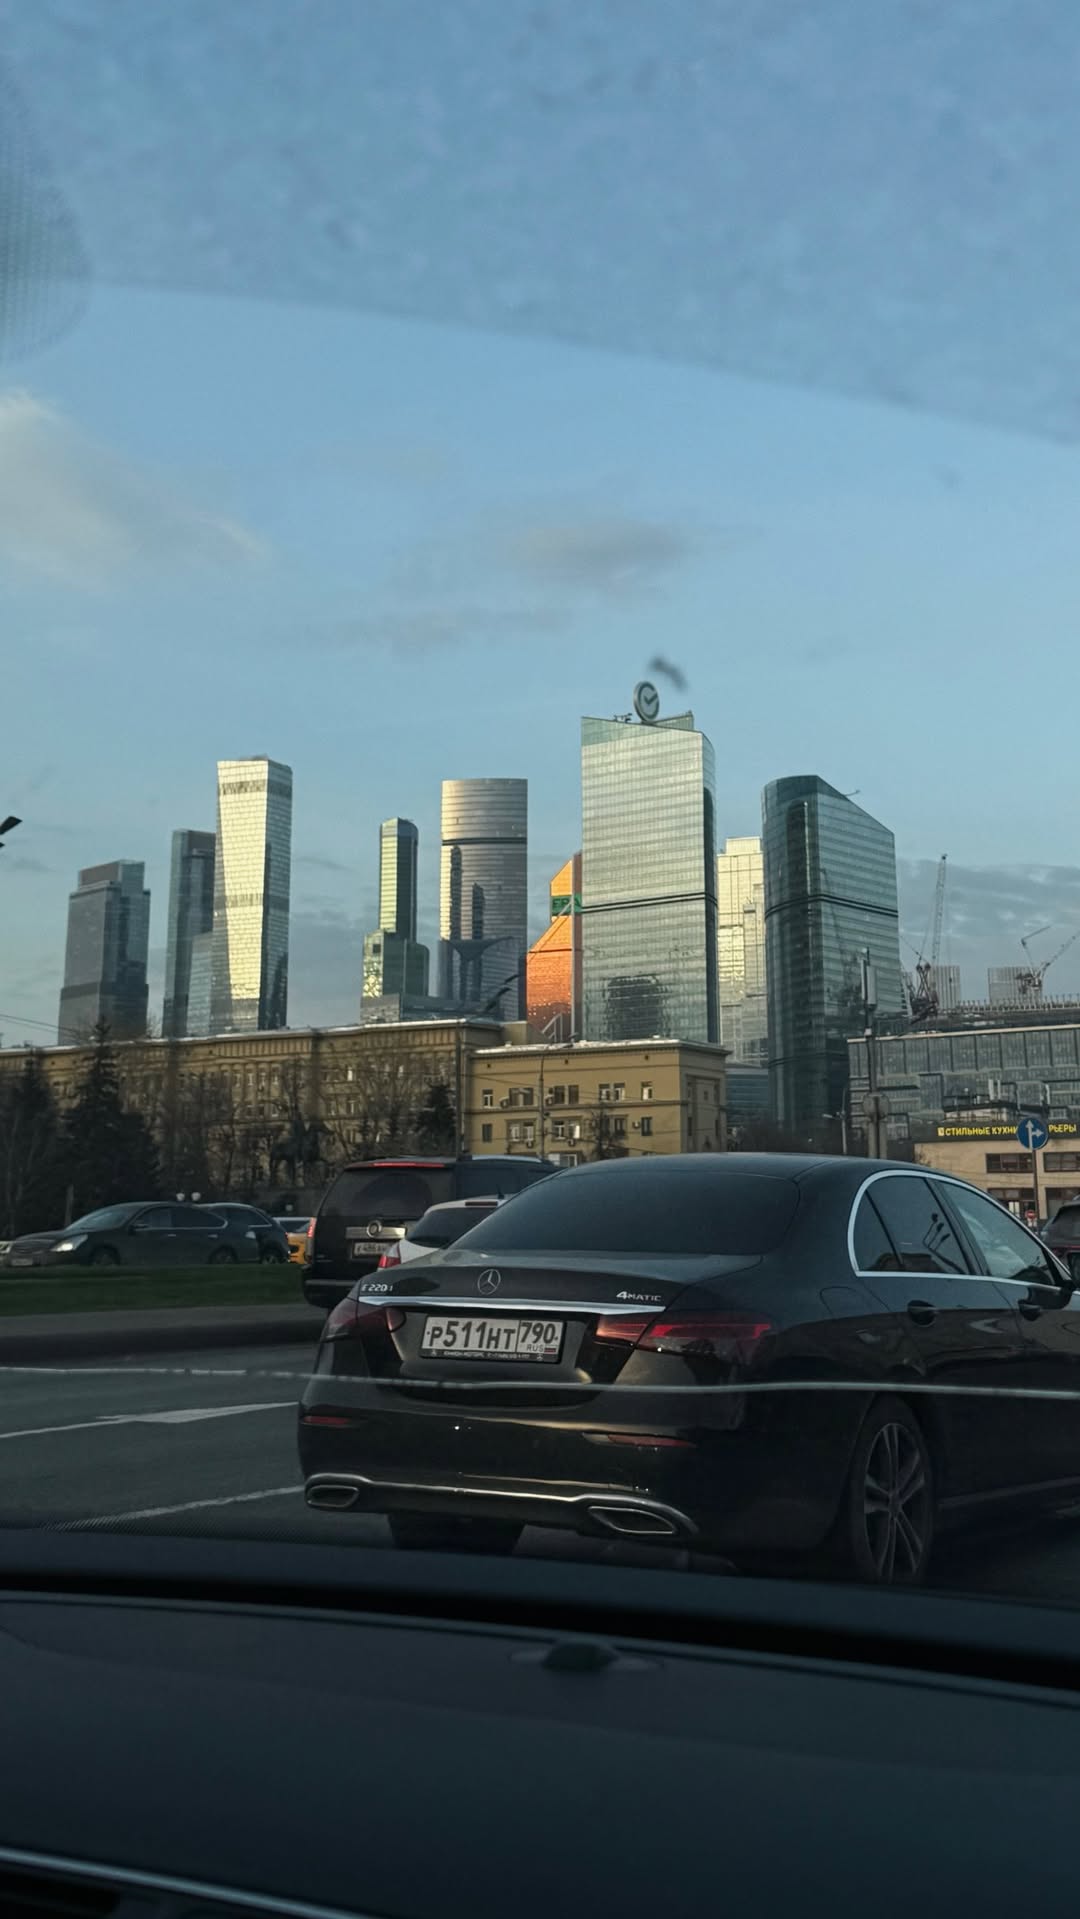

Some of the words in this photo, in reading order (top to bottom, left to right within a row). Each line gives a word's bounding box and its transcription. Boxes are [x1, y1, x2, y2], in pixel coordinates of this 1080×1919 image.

[945, 1127, 990, 1136] СТИЛЬНЫЕ
[1048, 1123, 1077, 1133] РЬЕРЫ
[616, 1290, 662, 1301] 4MATIC
[520, 1322, 556, 1344] 790
[526, 1344, 544, 1352] RUS
